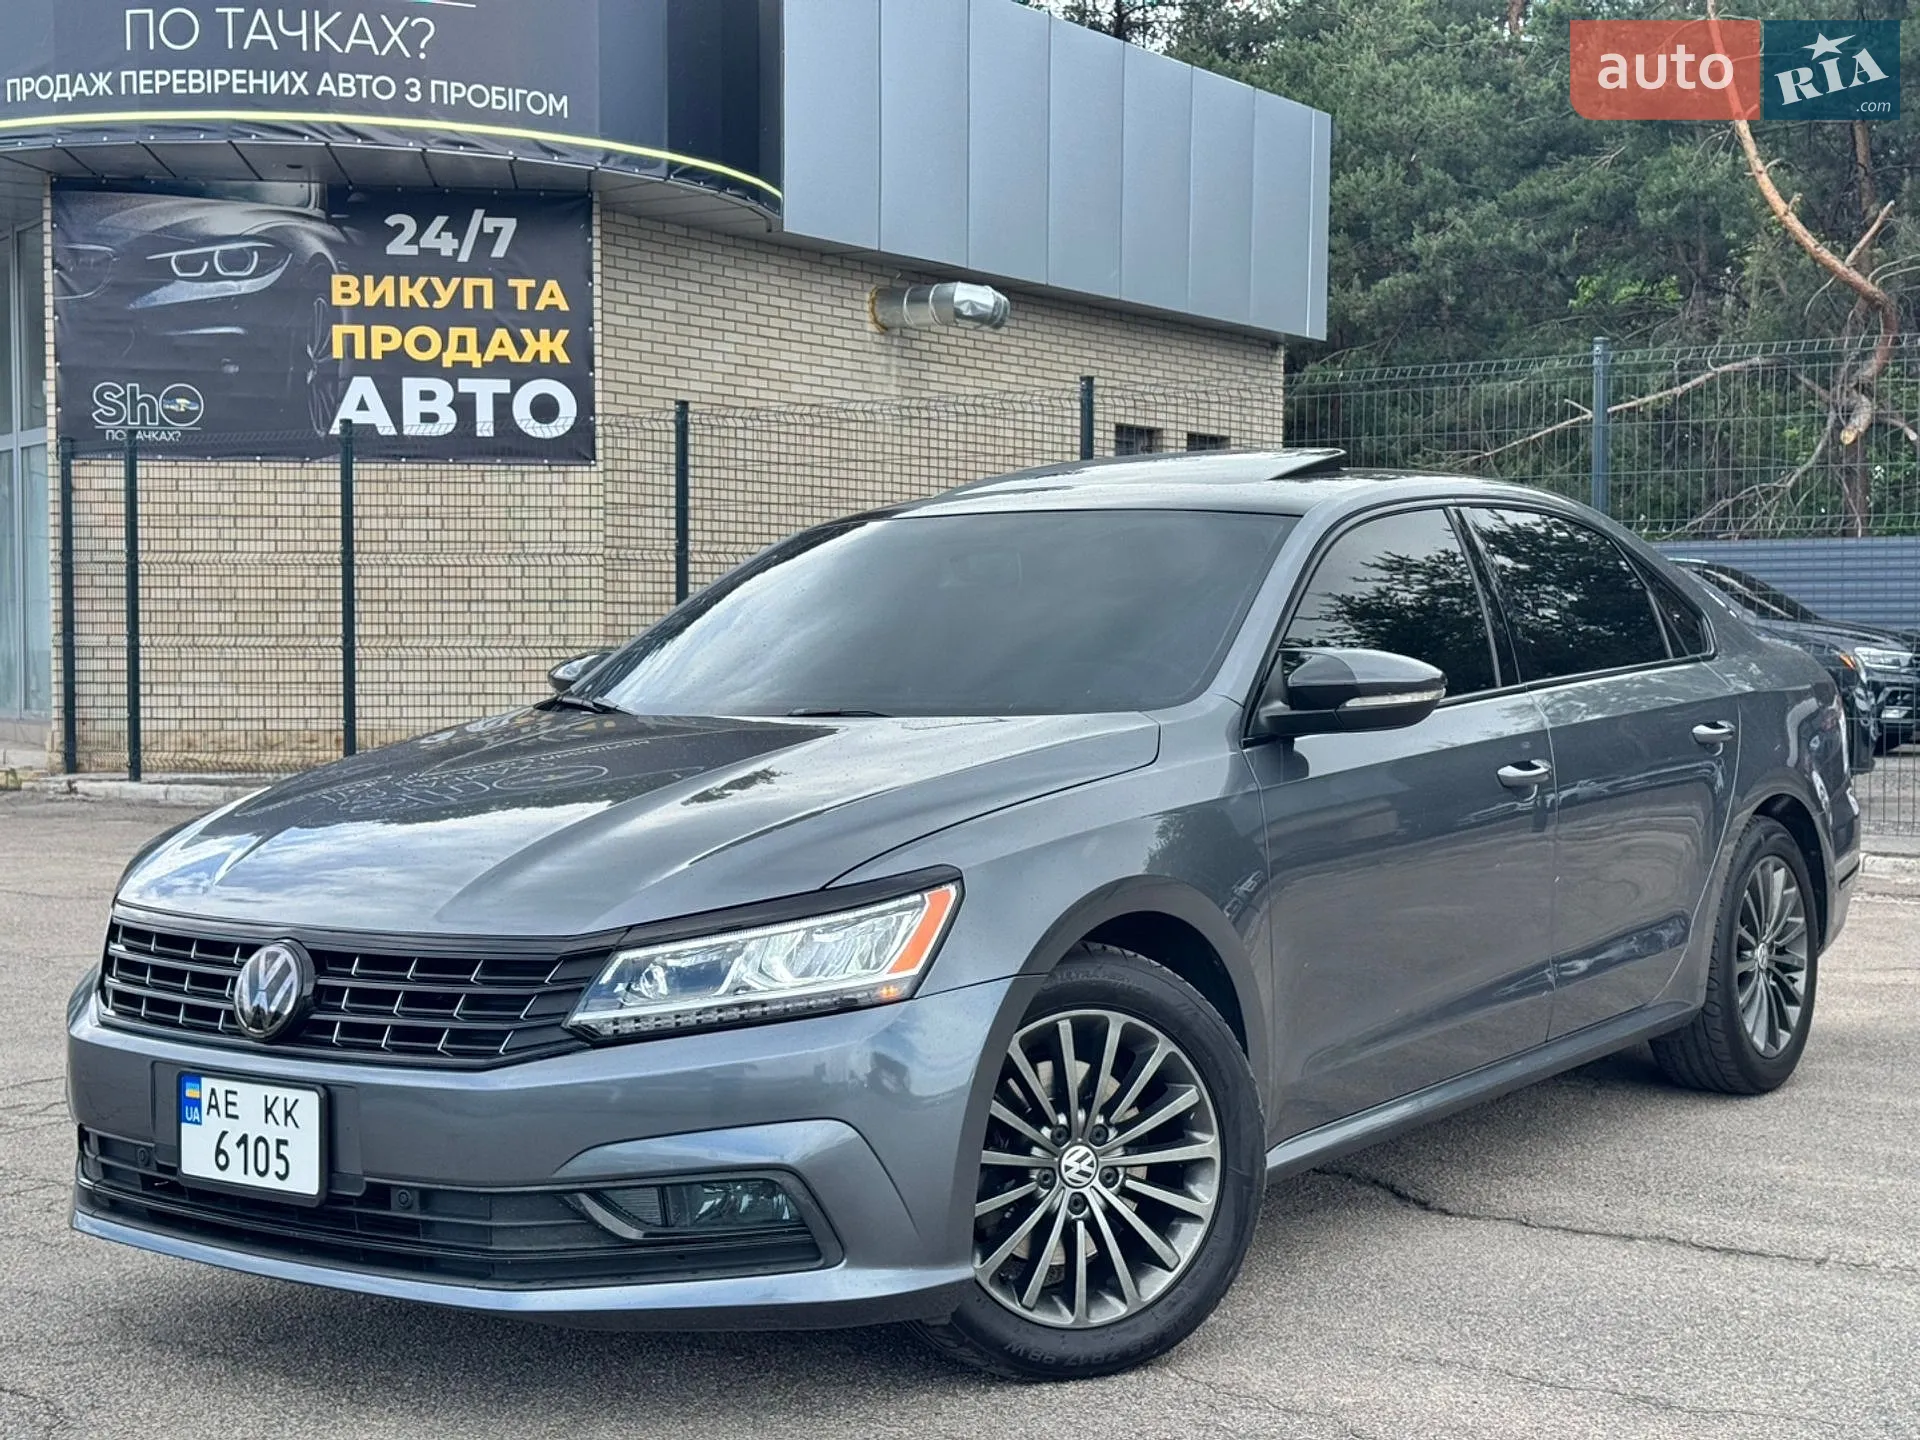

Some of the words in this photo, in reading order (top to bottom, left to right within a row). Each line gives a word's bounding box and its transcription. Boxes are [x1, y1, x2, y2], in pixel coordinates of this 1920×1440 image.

[125, 8, 199, 51] ПО
[216, 7, 436, 60] ТАЧКАХ?
[6, 71, 113, 103] ПРОДАЖ
[120, 69, 309, 96] ПЕРЕВІРЕНИХ
[317, 71, 397, 100] АВТО
[430, 79, 568, 119] ПРОБІГОМ
[384, 208, 518, 263] 24/7
[331, 274, 494, 310] ВИКУП
[508, 279, 570, 312] ТА
[331, 324, 571, 368] ПРОДАЖ
[328, 376, 578, 439] АВТО
[131, 430, 182, 442] АЧКАХ?
[185, 1105, 200, 1122] UA
[206, 1087, 239, 1120] AE
[264, 1094, 300, 1129] KK
[214, 1130, 290, 1181] 6105
